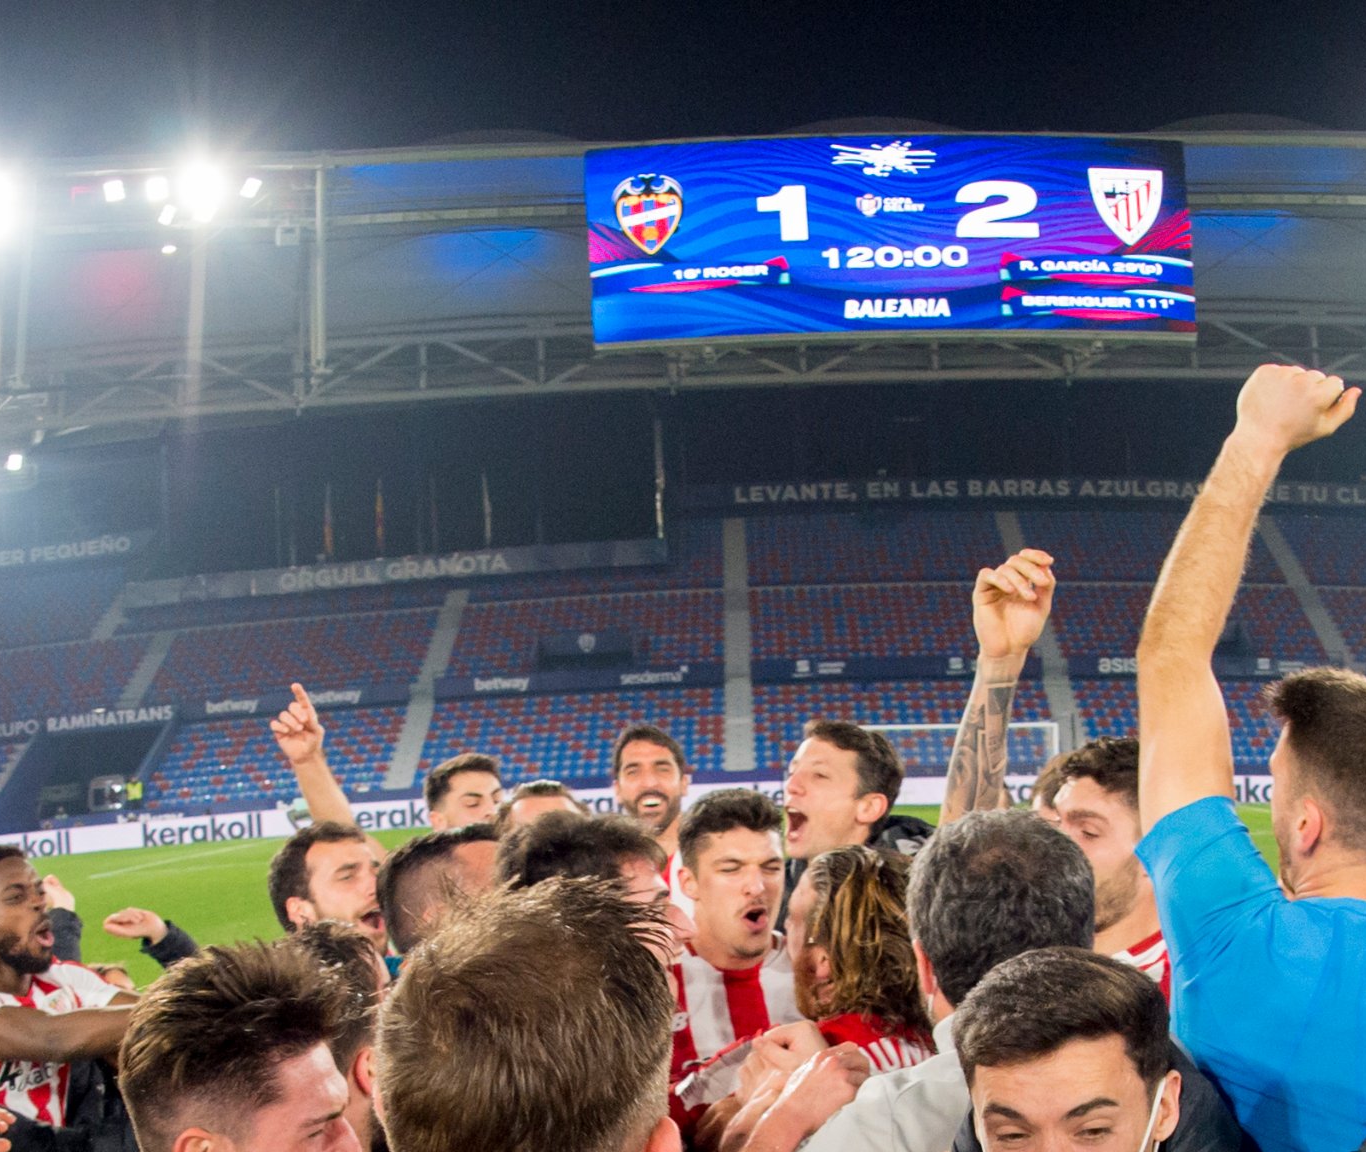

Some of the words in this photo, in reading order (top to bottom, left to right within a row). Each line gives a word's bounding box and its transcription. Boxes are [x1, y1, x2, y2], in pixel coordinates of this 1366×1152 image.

[757, 185, 809, 242] 1
[956, 180, 1040, 238] 2
[820, 245, 969, 270] 120:00
[1019, 260, 1040, 272] R.
[1041, 259, 1110, 272] GARCÍA
[704, 265, 770, 279] ROGER
[1022, 294, 1132, 307] BERENGUER
[736, 482, 857, 502] LEVANTE,
[867, 481, 901, 498] EN
[911, 480, 958, 497] LAS
[968, 479, 1070, 498] BARRAS
[1297, 486, 1328, 502] TU
[30, 534, 132, 563] PEQUEÑO
[280, 565, 381, 592] ORGULL
[386, 552, 512, 582] GRANOTA
[1099, 657, 1139, 673] asis
[142, 811, 263, 848] kerakoll
